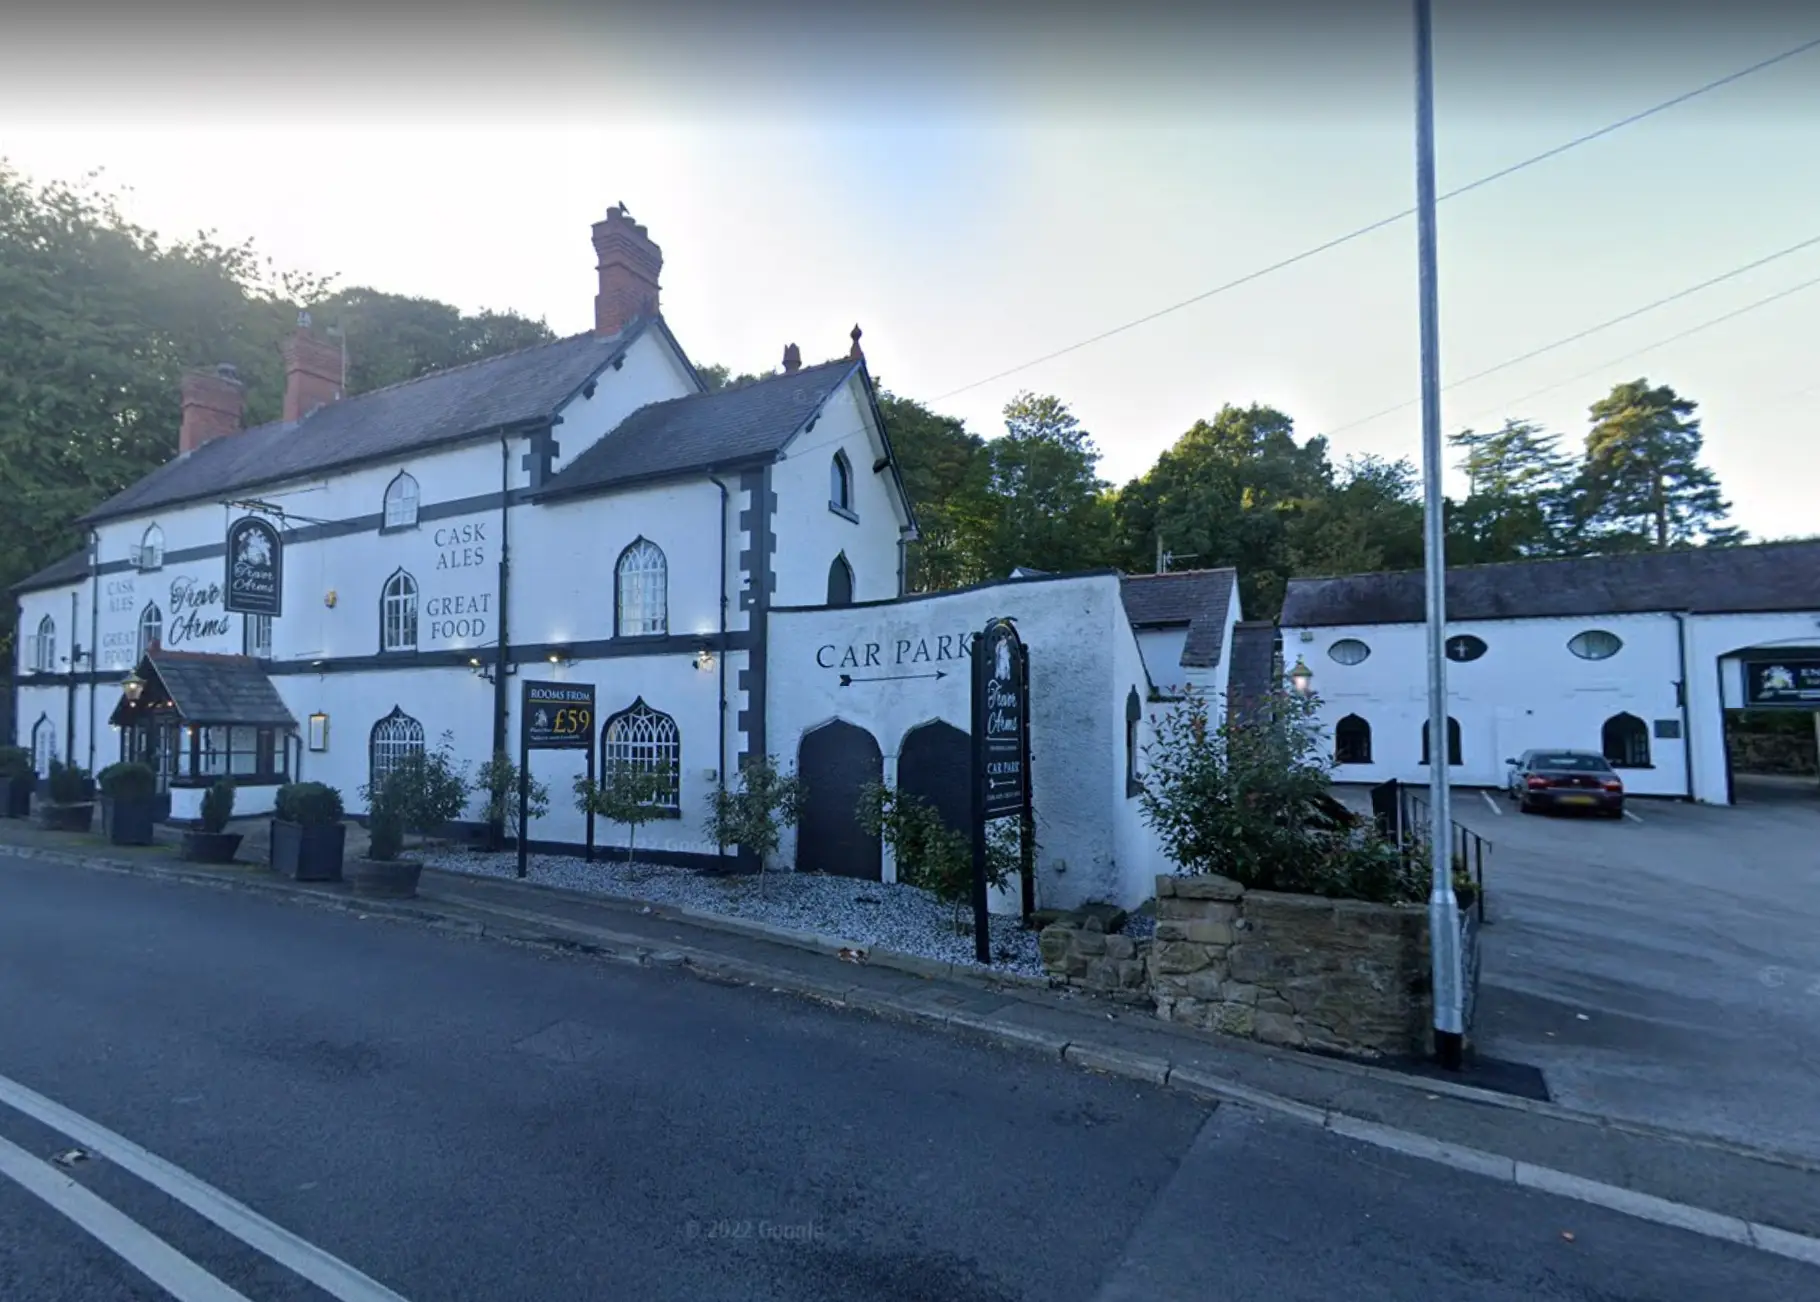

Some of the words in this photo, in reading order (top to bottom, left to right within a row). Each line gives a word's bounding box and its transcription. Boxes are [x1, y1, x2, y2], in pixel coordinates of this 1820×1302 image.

[434, 523, 486, 547] CASK
[436, 547, 484, 570] ALES
[107, 579, 135, 596] CASK
[233, 579, 274, 593] Arms
[426, 593, 491, 617] GREAT
[168, 609, 230, 646] Arms
[431, 618, 485, 639] FOOD
[816, 643, 881, 669] CAR
[896, 631, 974, 664] PARK
[531, 688, 564, 699] ROOMS
[567, 690, 591, 701] FROM
[553, 708, 590, 734] £59
[987, 709, 1018, 735] Arms
[988, 762, 1002, 775] CAR
[1003, 761, 1020, 774] PARK
